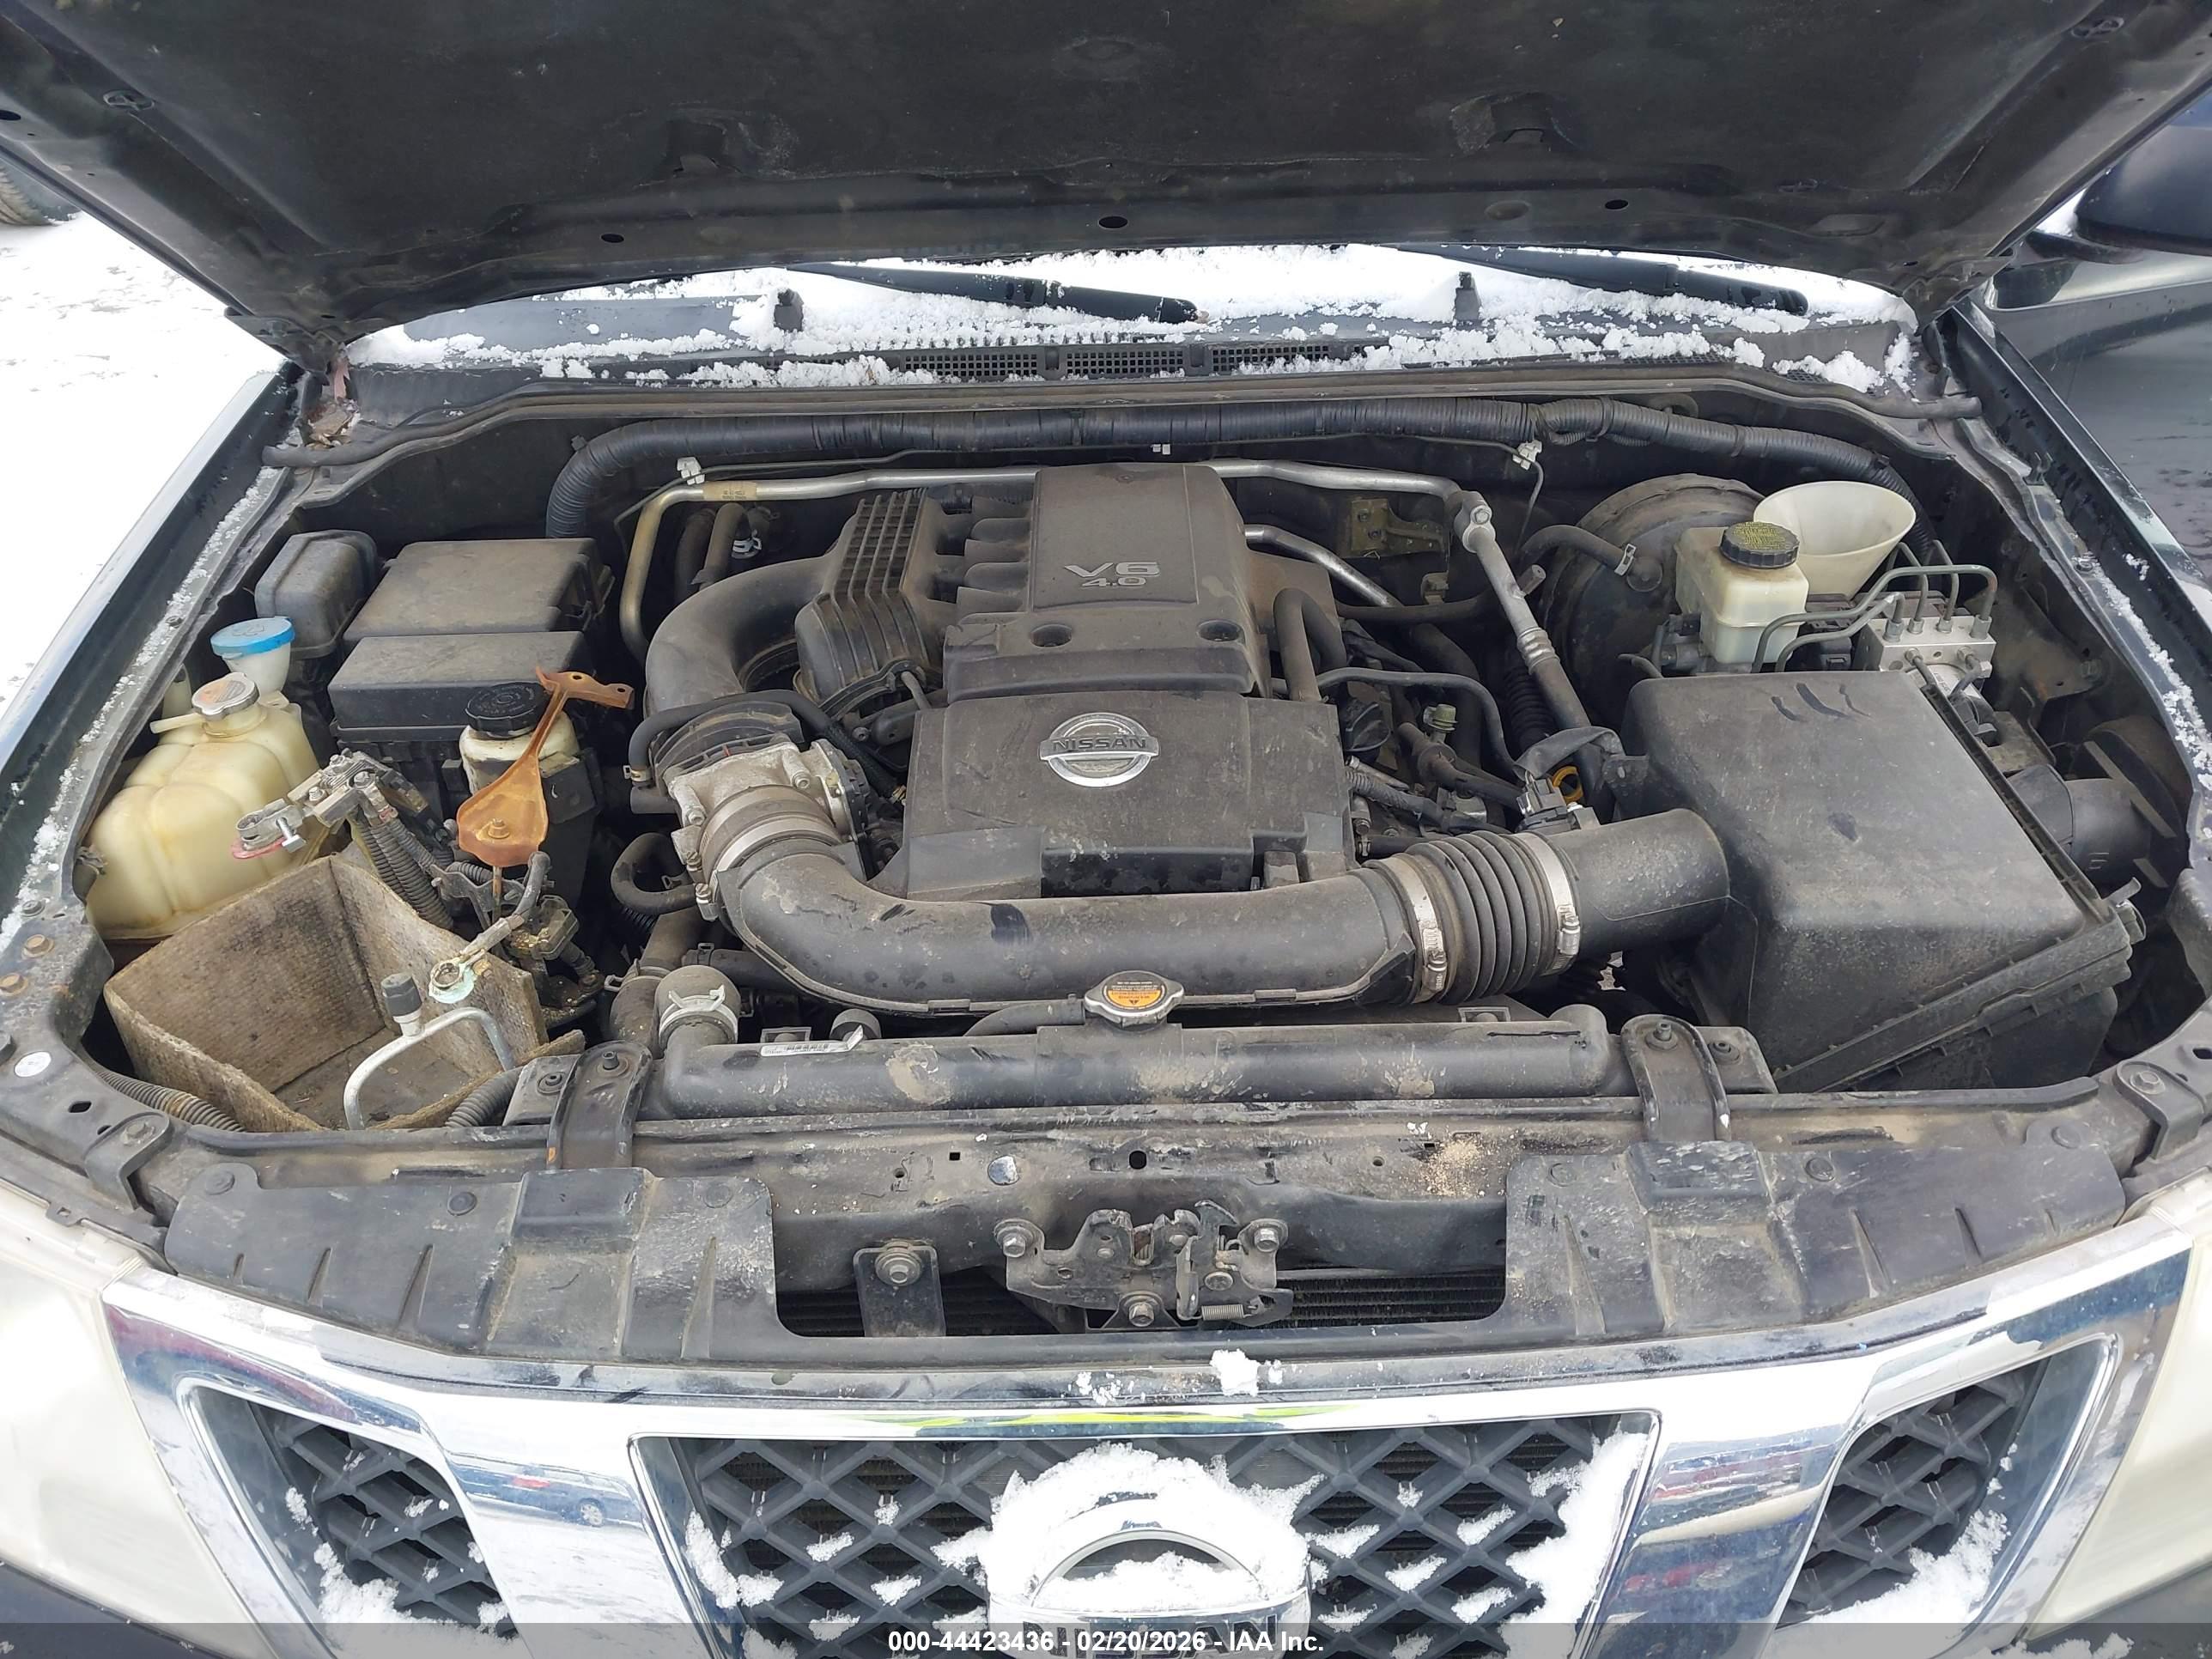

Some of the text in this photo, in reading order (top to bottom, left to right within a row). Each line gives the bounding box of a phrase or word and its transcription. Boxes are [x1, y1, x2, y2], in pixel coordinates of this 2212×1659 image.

[1064, 561, 1160, 577] V6
[1080, 577, 1147, 587] 4.0
[1052, 737, 1147, 751] NISSAN
